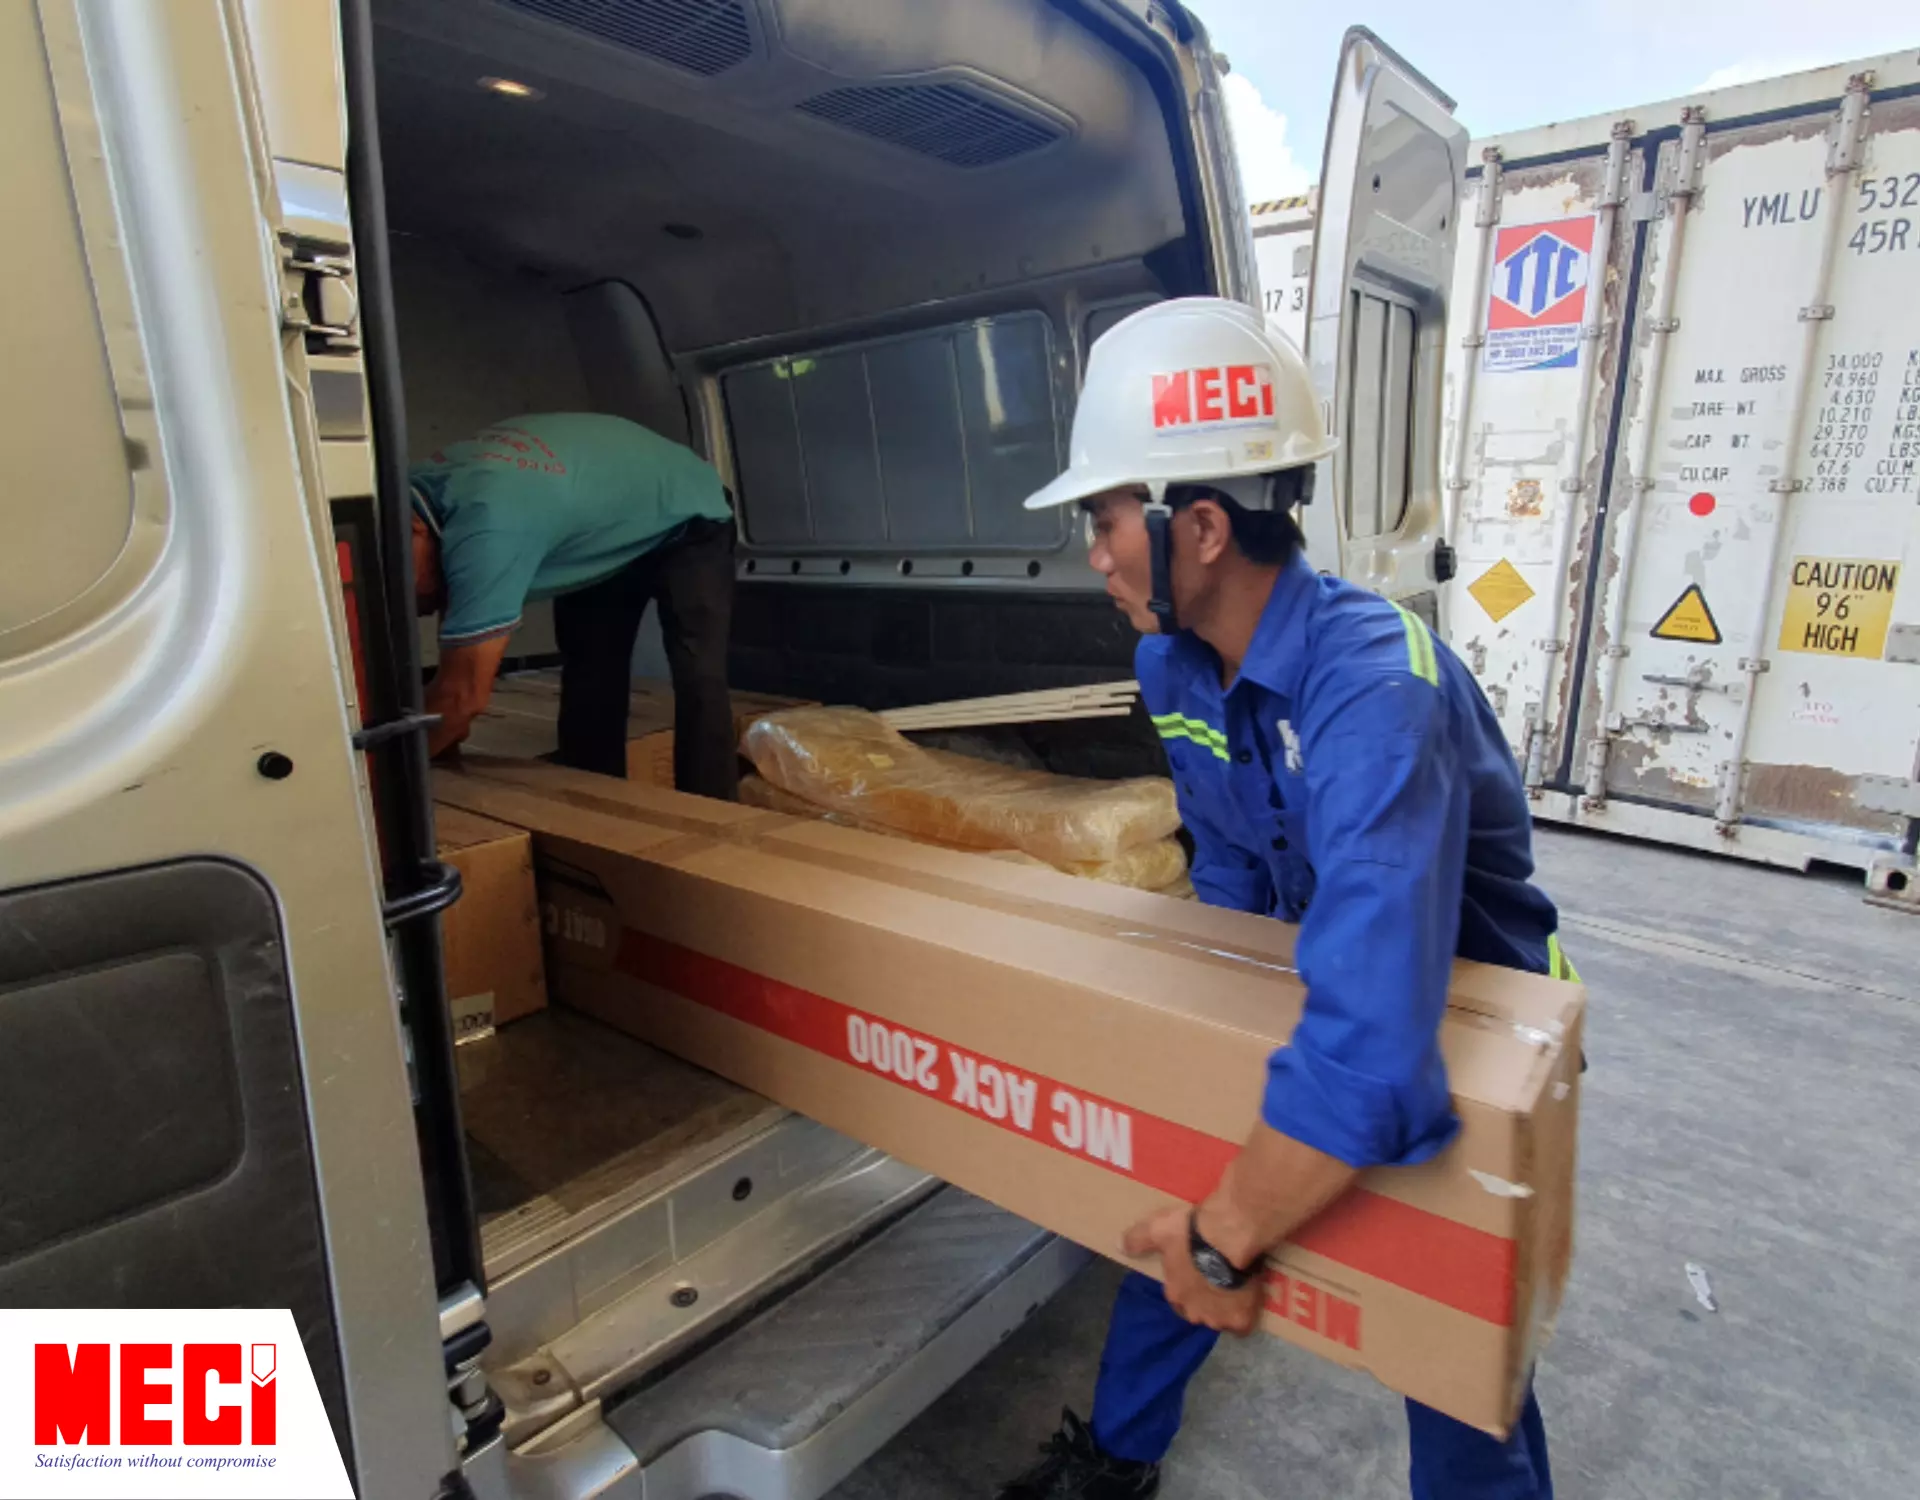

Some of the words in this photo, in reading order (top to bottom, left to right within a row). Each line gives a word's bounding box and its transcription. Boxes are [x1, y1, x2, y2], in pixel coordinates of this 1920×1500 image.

[1743, 187, 1821, 228] YMLU
[1848, 218, 1920, 255] 45R
[1504, 234, 1580, 316] TTC
[1740, 365, 1787, 384] GROSS
[1691, 401, 1725, 417] TARE
[1819, 406, 1872, 423] 10.210
[1813, 424, 1868, 441] 29.370
[1817, 459, 1851, 476] 67.6
[1791, 561, 1897, 593] CAUTION
[1802, 622, 1859, 652] HIGH
[847, 1014, 940, 1091] 2000
[948, 1051, 1038, 1132] ACK
[1051, 1089, 1134, 1172] MC
[1263, 1268, 1361, 1351] MEC
